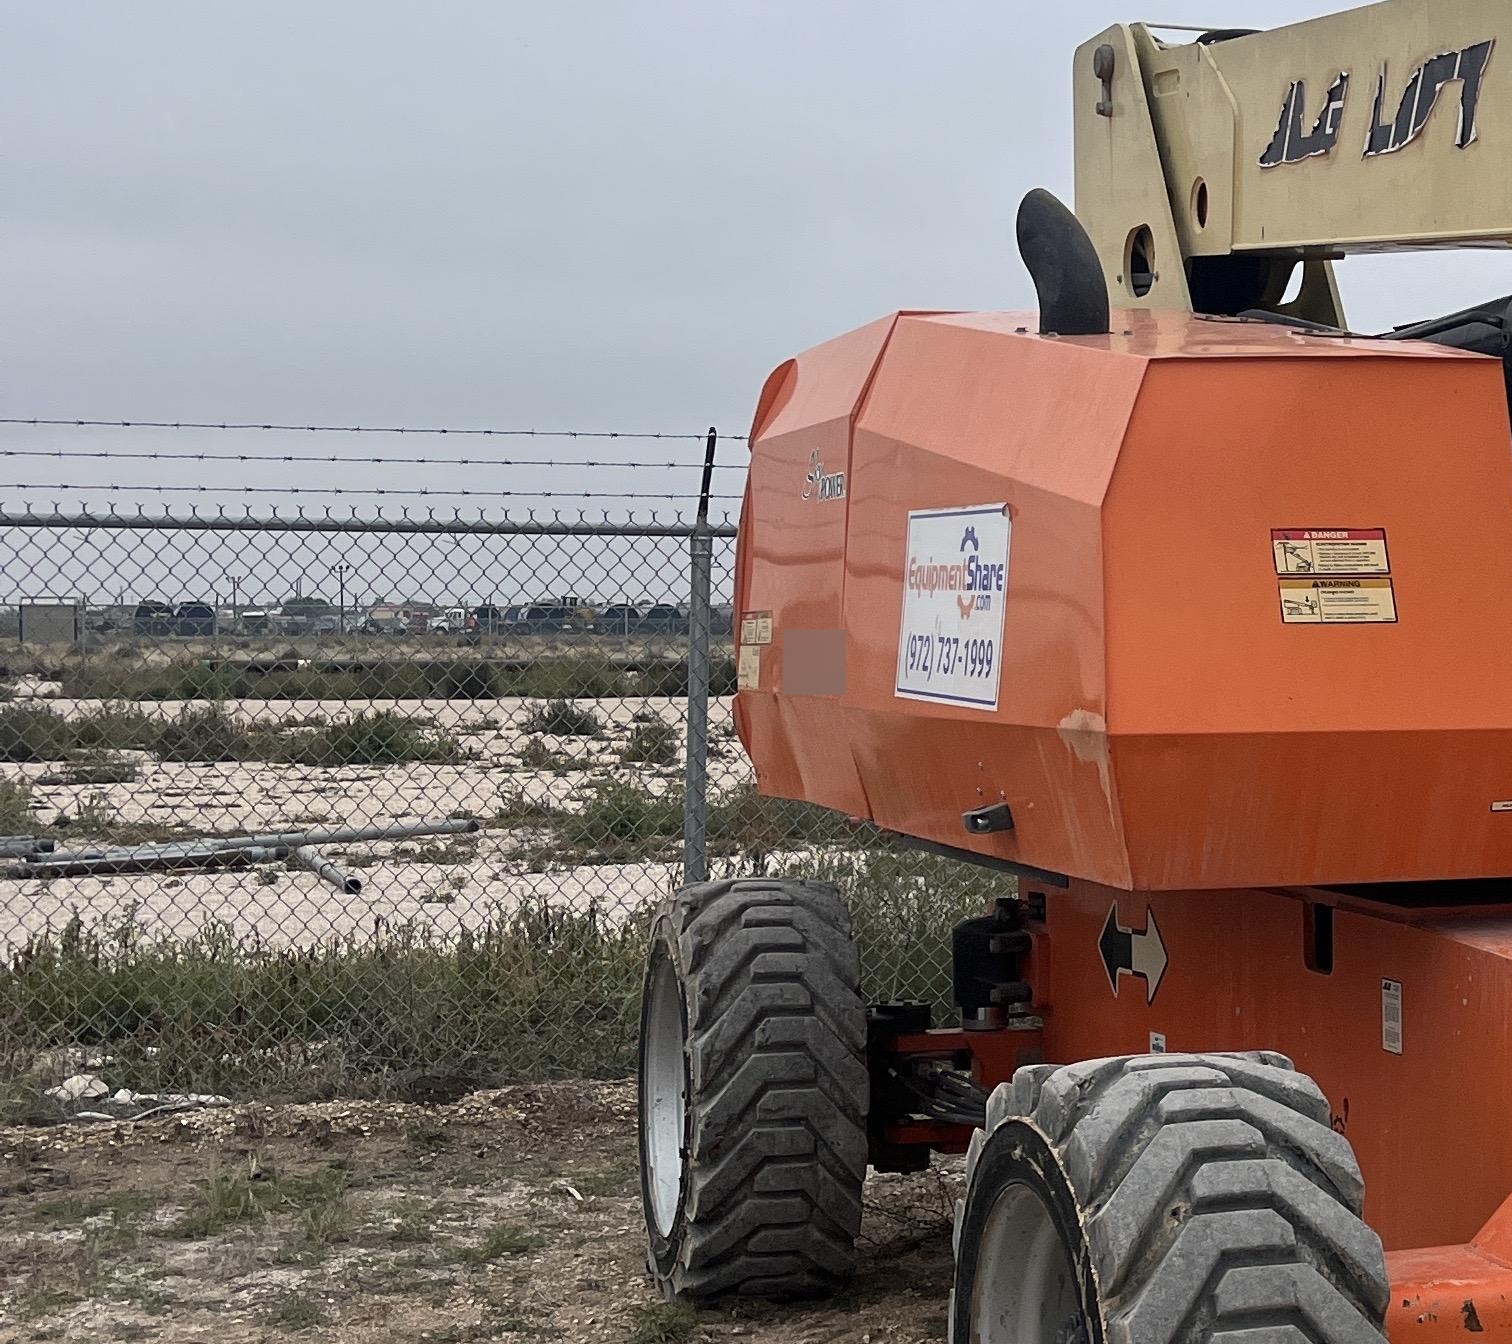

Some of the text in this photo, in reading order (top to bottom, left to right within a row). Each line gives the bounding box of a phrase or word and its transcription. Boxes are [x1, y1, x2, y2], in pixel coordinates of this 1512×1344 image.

[1311, 531, 1349, 539] DANGER
[908, 554, 1004, 599] EquipmentShare
[1319, 580, 1361, 588] WARNING
[905, 632, 994, 682] (972) 737-1999
